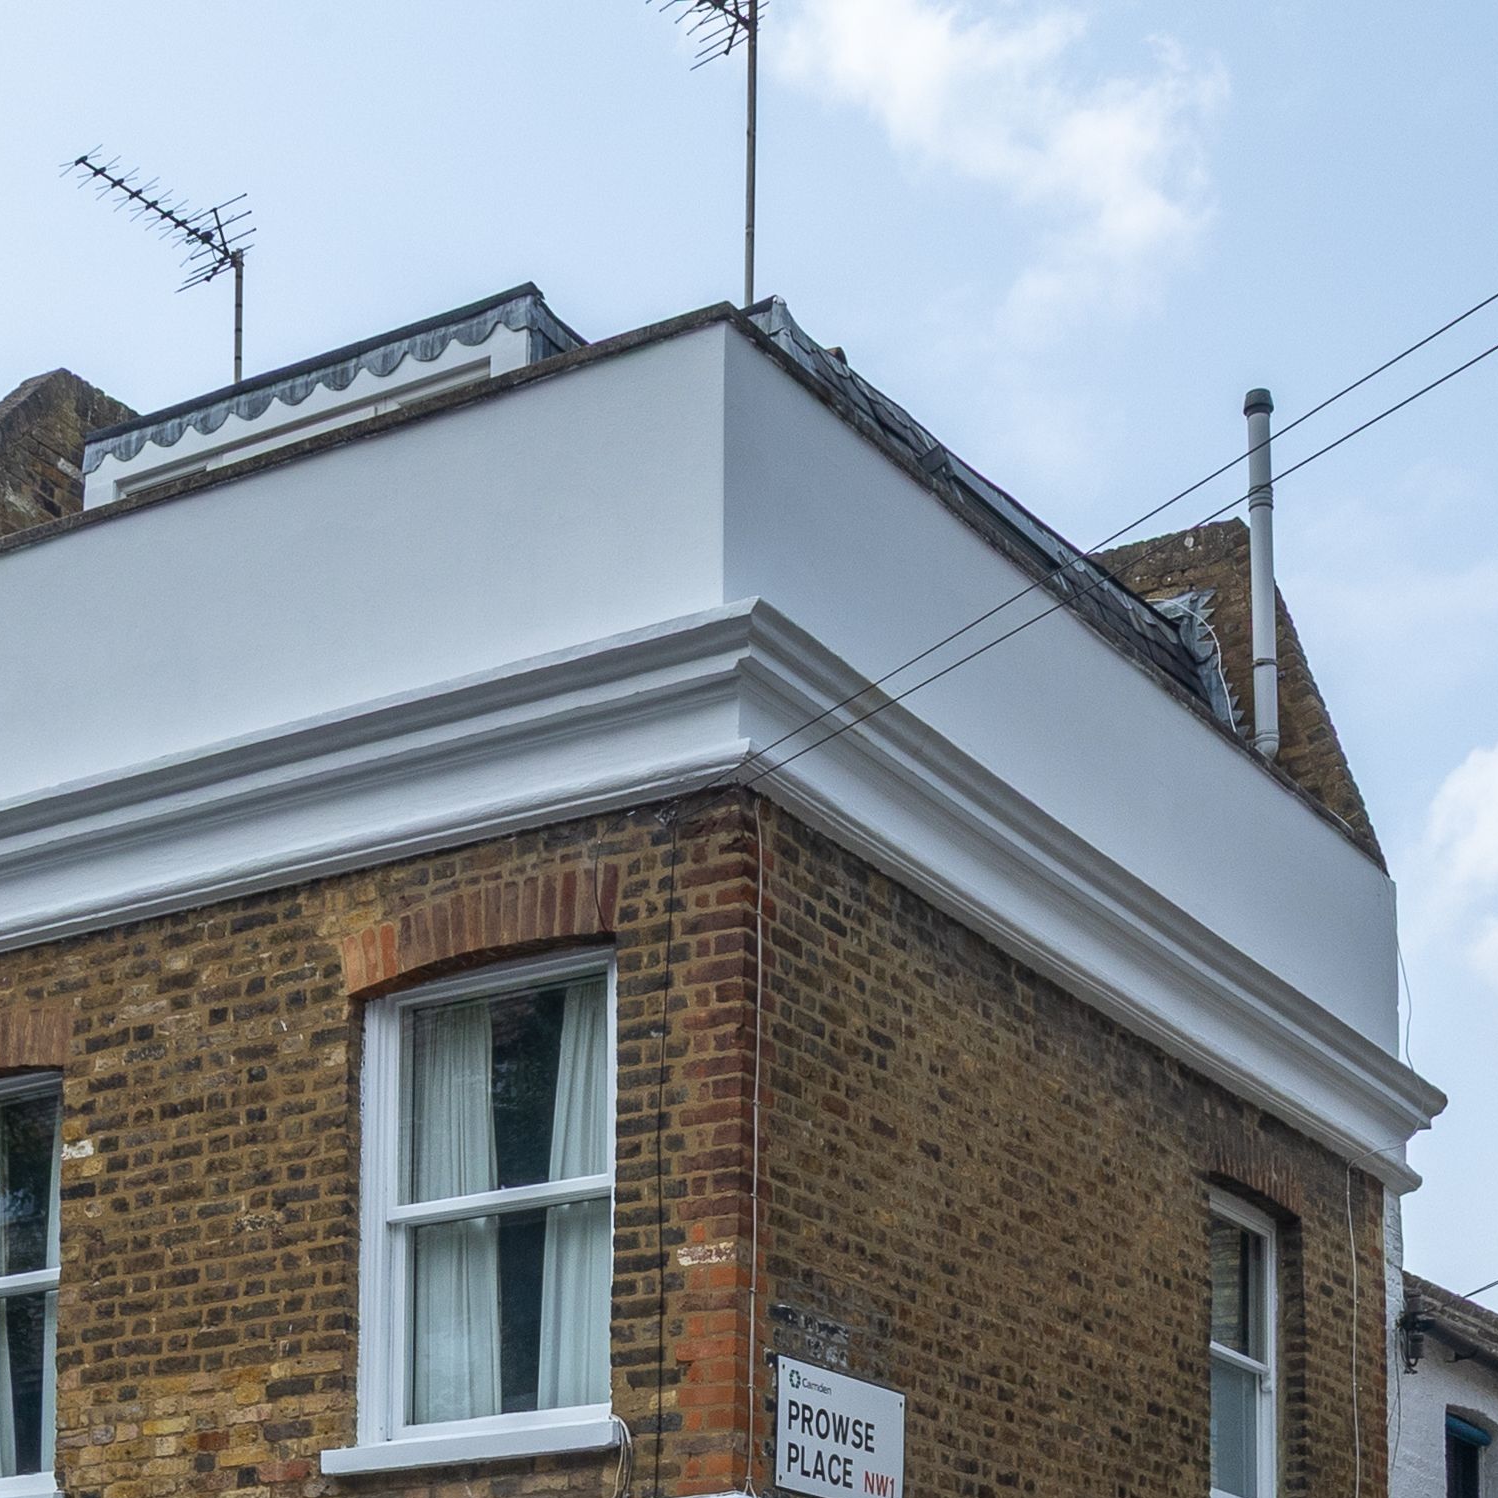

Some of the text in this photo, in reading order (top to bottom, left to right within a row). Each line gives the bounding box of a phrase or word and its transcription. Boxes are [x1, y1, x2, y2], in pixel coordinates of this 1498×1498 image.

[802, 1377, 832, 1395] Camden
[788, 1399, 875, 1453] PROWSE
[787, 1442, 854, 1489] PLACE
